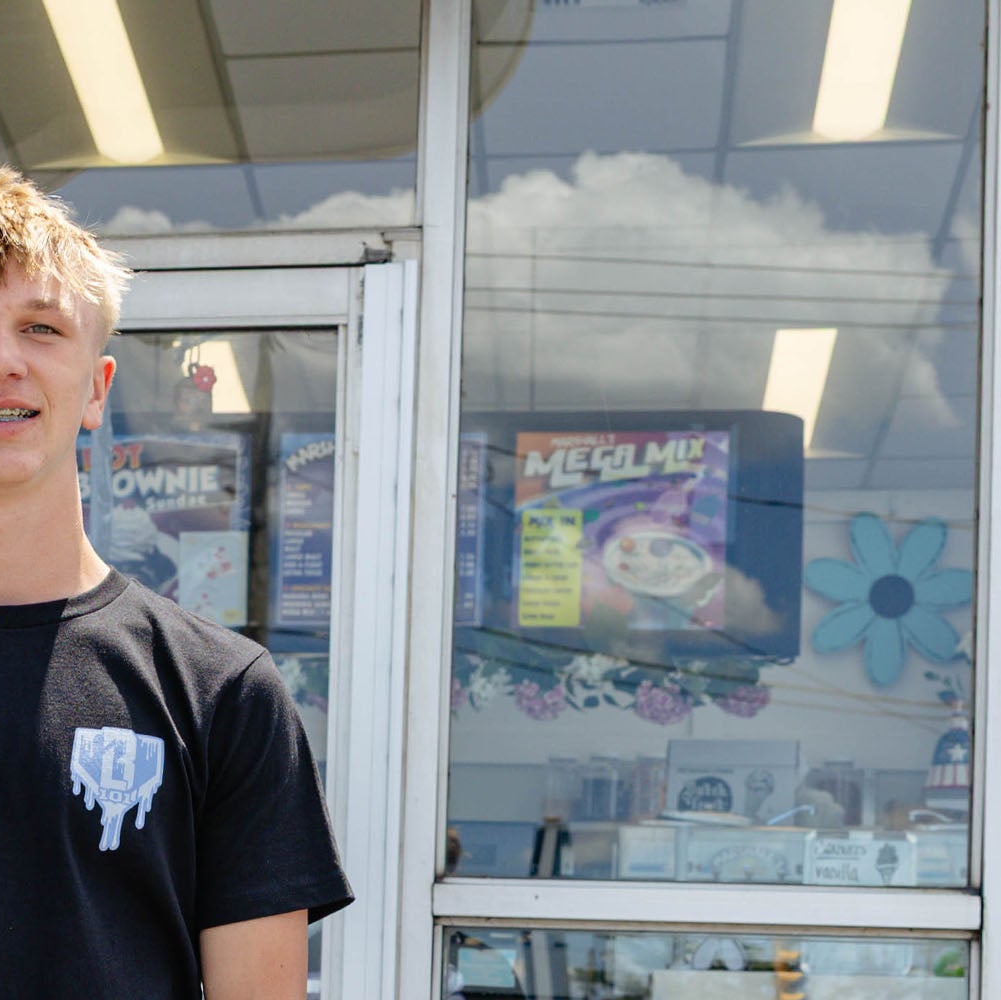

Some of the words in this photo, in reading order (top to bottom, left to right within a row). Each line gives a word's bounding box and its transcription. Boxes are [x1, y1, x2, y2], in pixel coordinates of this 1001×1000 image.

[79, 464, 219, 499] BOWNIE
[523, 444, 652, 488] MEGA
[644, 437, 708, 473] MIX
